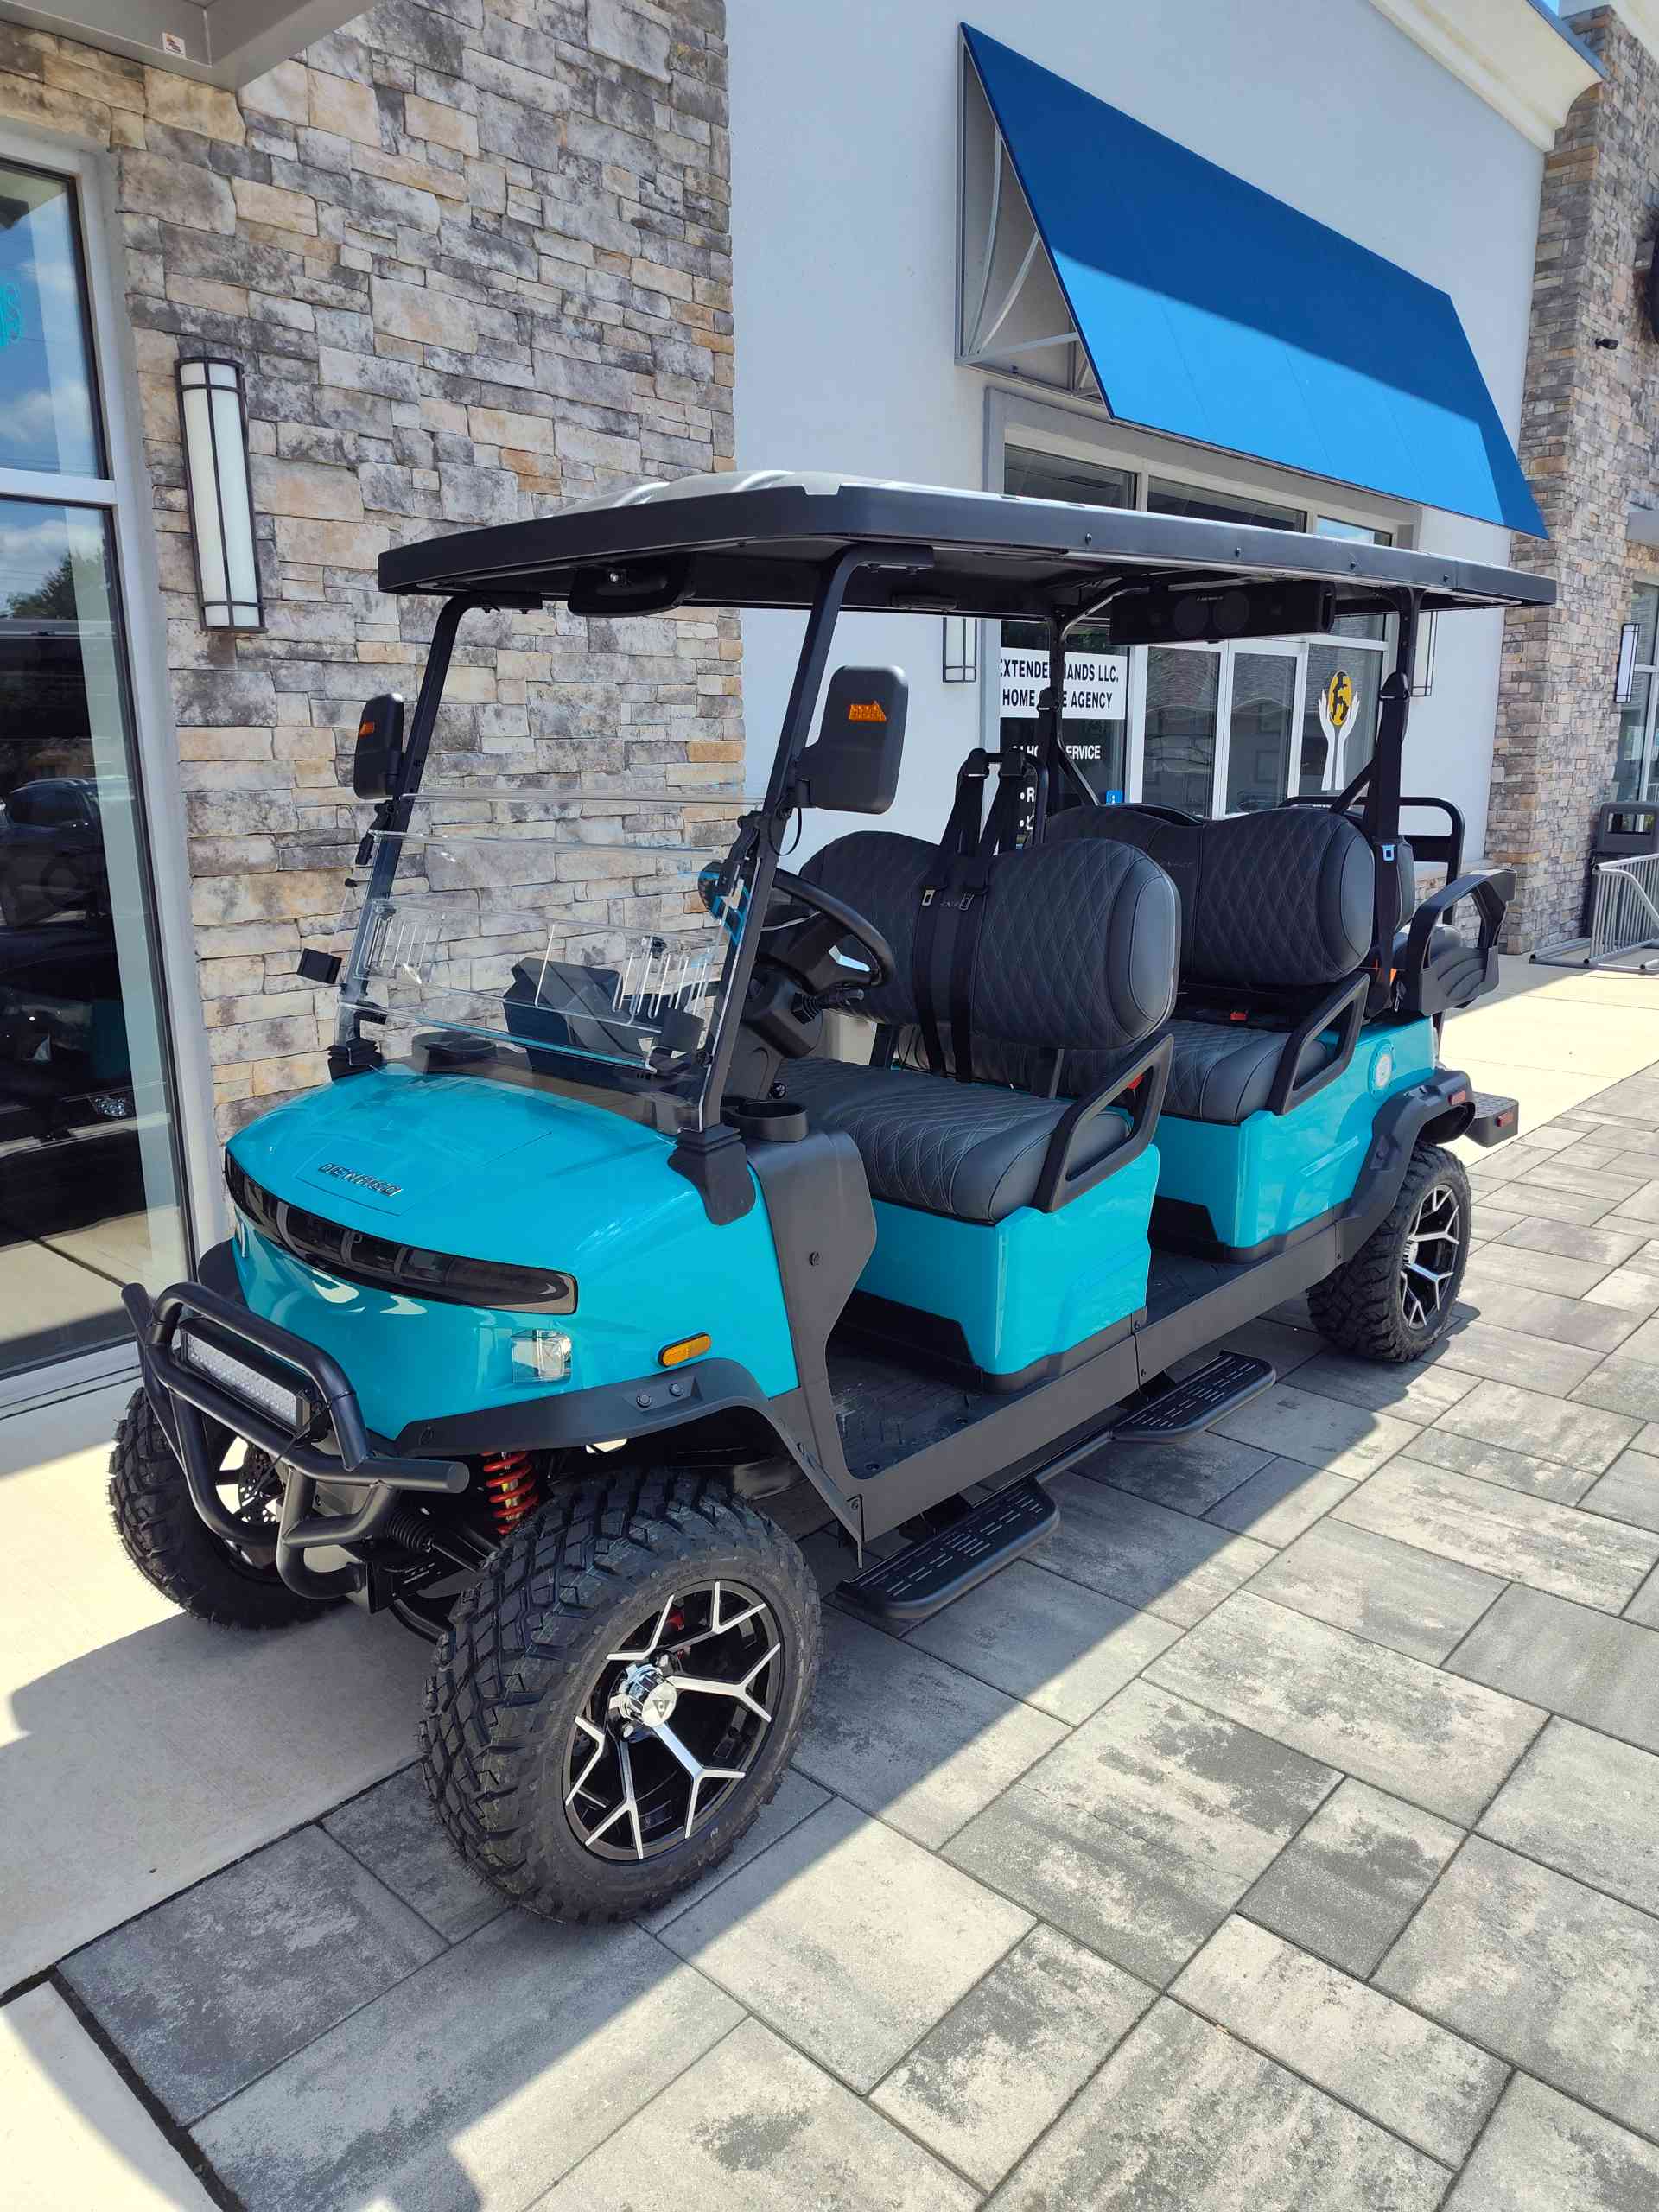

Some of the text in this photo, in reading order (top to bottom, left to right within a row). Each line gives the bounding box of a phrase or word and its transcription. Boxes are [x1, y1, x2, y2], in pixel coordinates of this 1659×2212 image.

[1001, 658, 1119, 683] XTENDE ANDS LLC.
[1002, 688, 1035, 707] HOME
[1071, 691, 1113, 709] AGENCY
[1065, 745, 1101, 760] ERVICE
